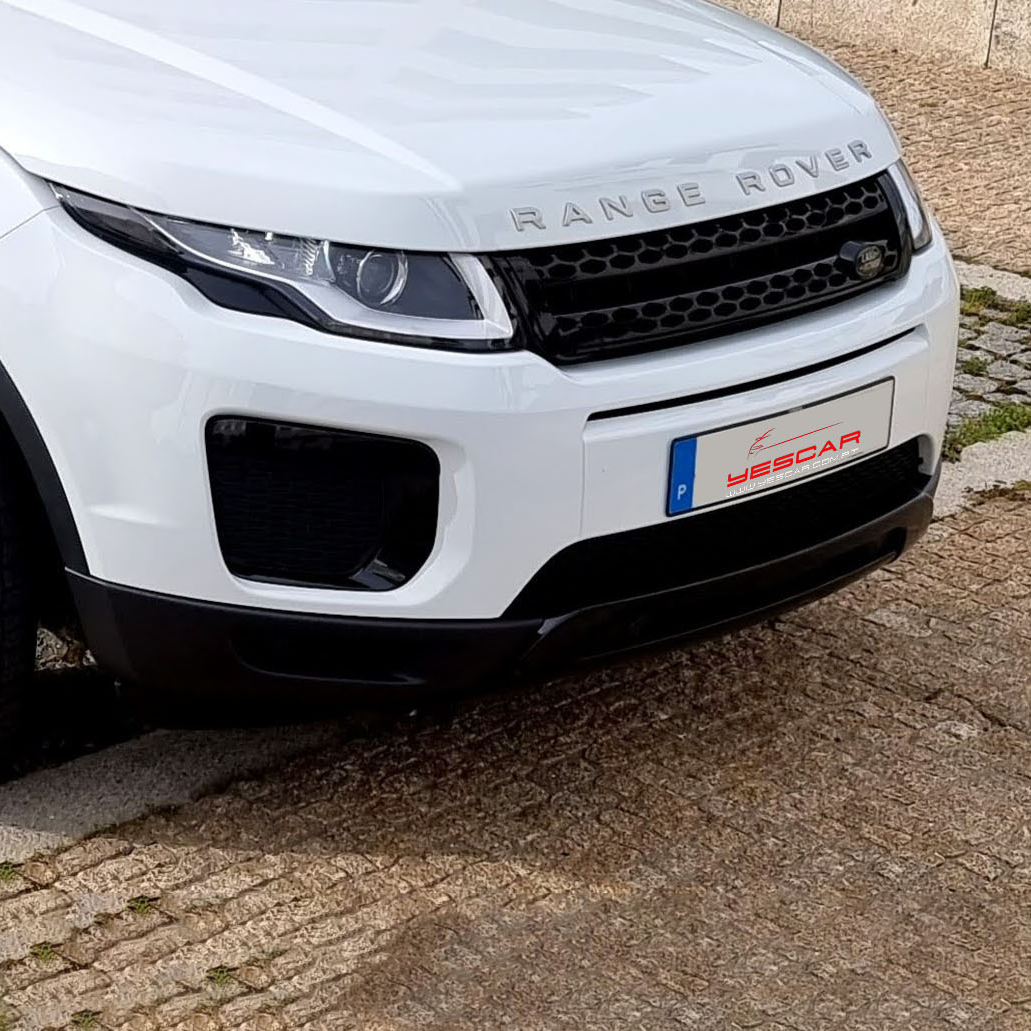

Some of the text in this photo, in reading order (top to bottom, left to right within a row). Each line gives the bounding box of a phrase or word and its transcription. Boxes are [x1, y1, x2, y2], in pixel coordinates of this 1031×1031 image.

[509, 139, 873, 232] RANGE ROVER
[677, 484, 687, 500] P
